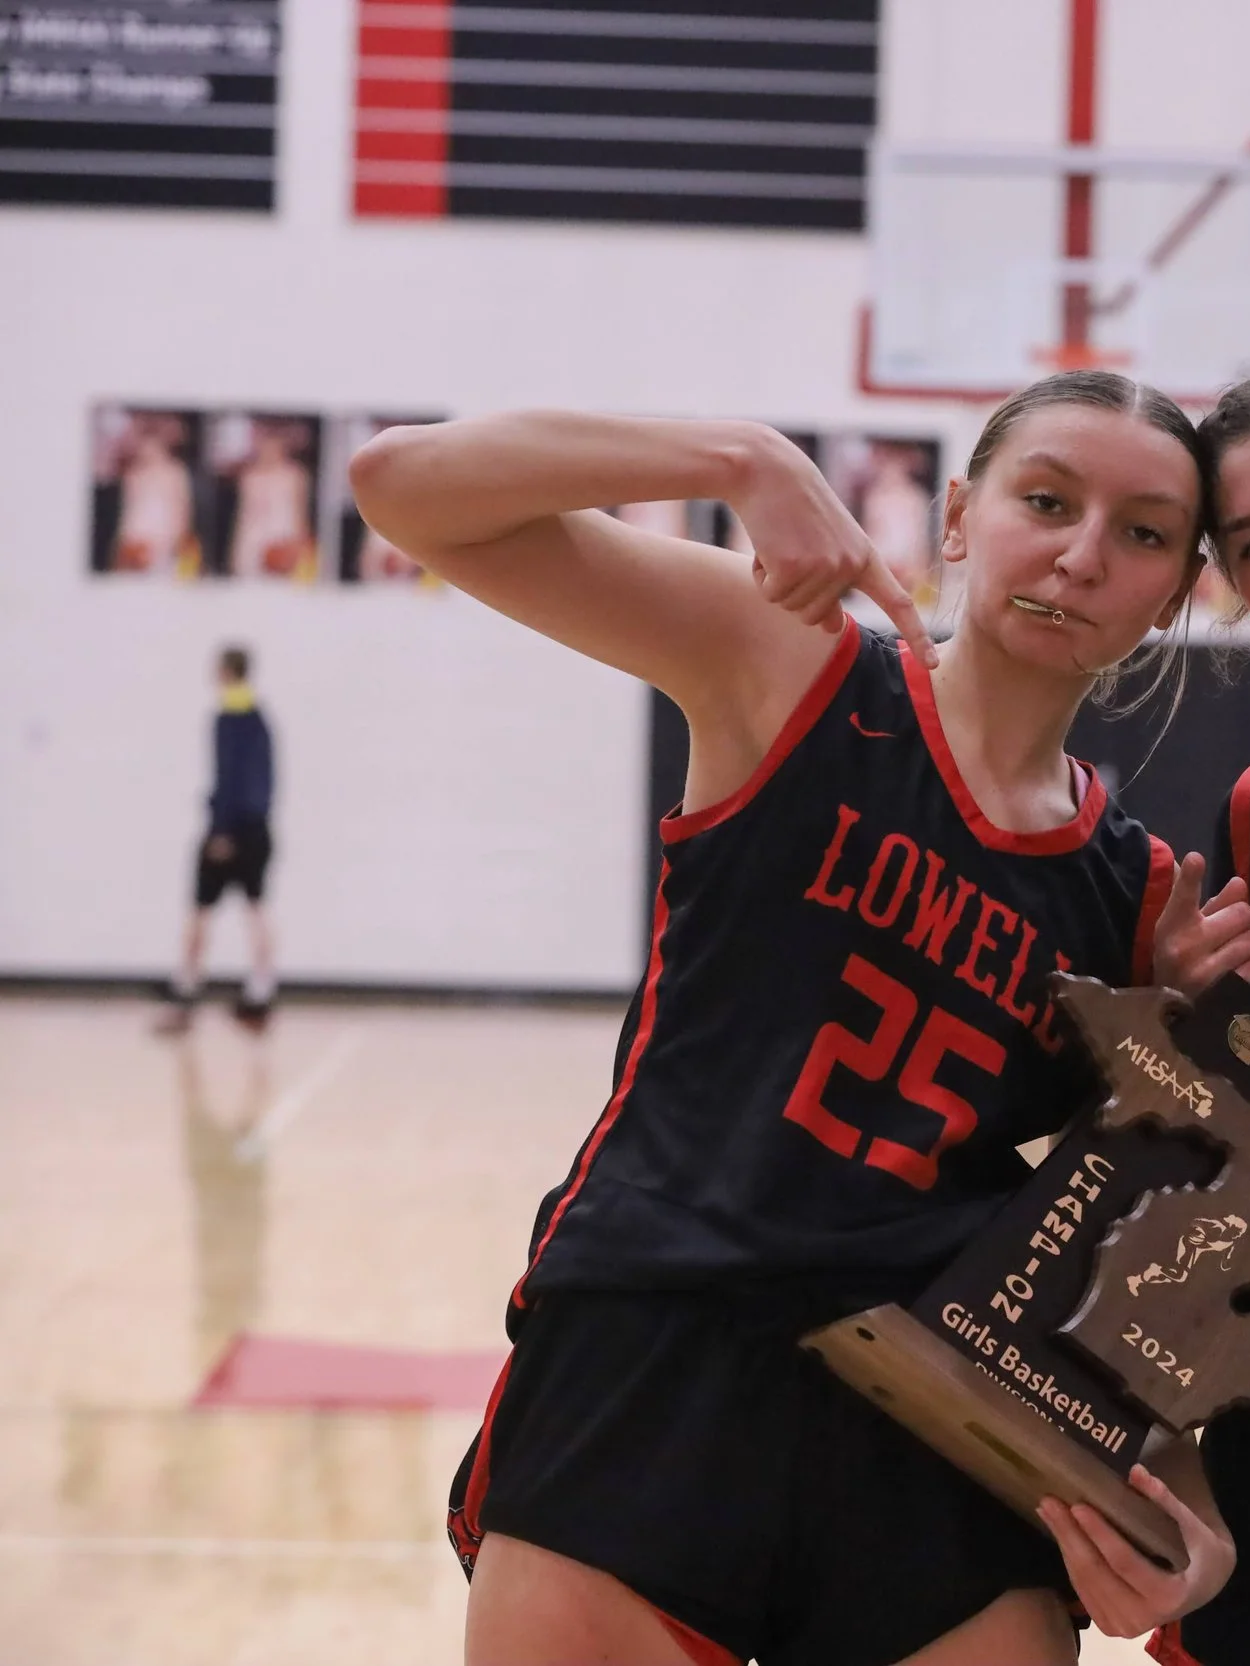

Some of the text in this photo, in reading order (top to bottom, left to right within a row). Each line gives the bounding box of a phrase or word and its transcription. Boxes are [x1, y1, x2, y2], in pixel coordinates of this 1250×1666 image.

[782, 953, 1007, 1190] 25
[1116, 1035, 1199, 1110] MHSAA
[990, 1153, 1115, 1324] CHAMPION
[941, 1302, 998, 1356] Girls
[998, 1344, 1128, 1454] Basketball
[1121, 1322, 1196, 1388] 2024
